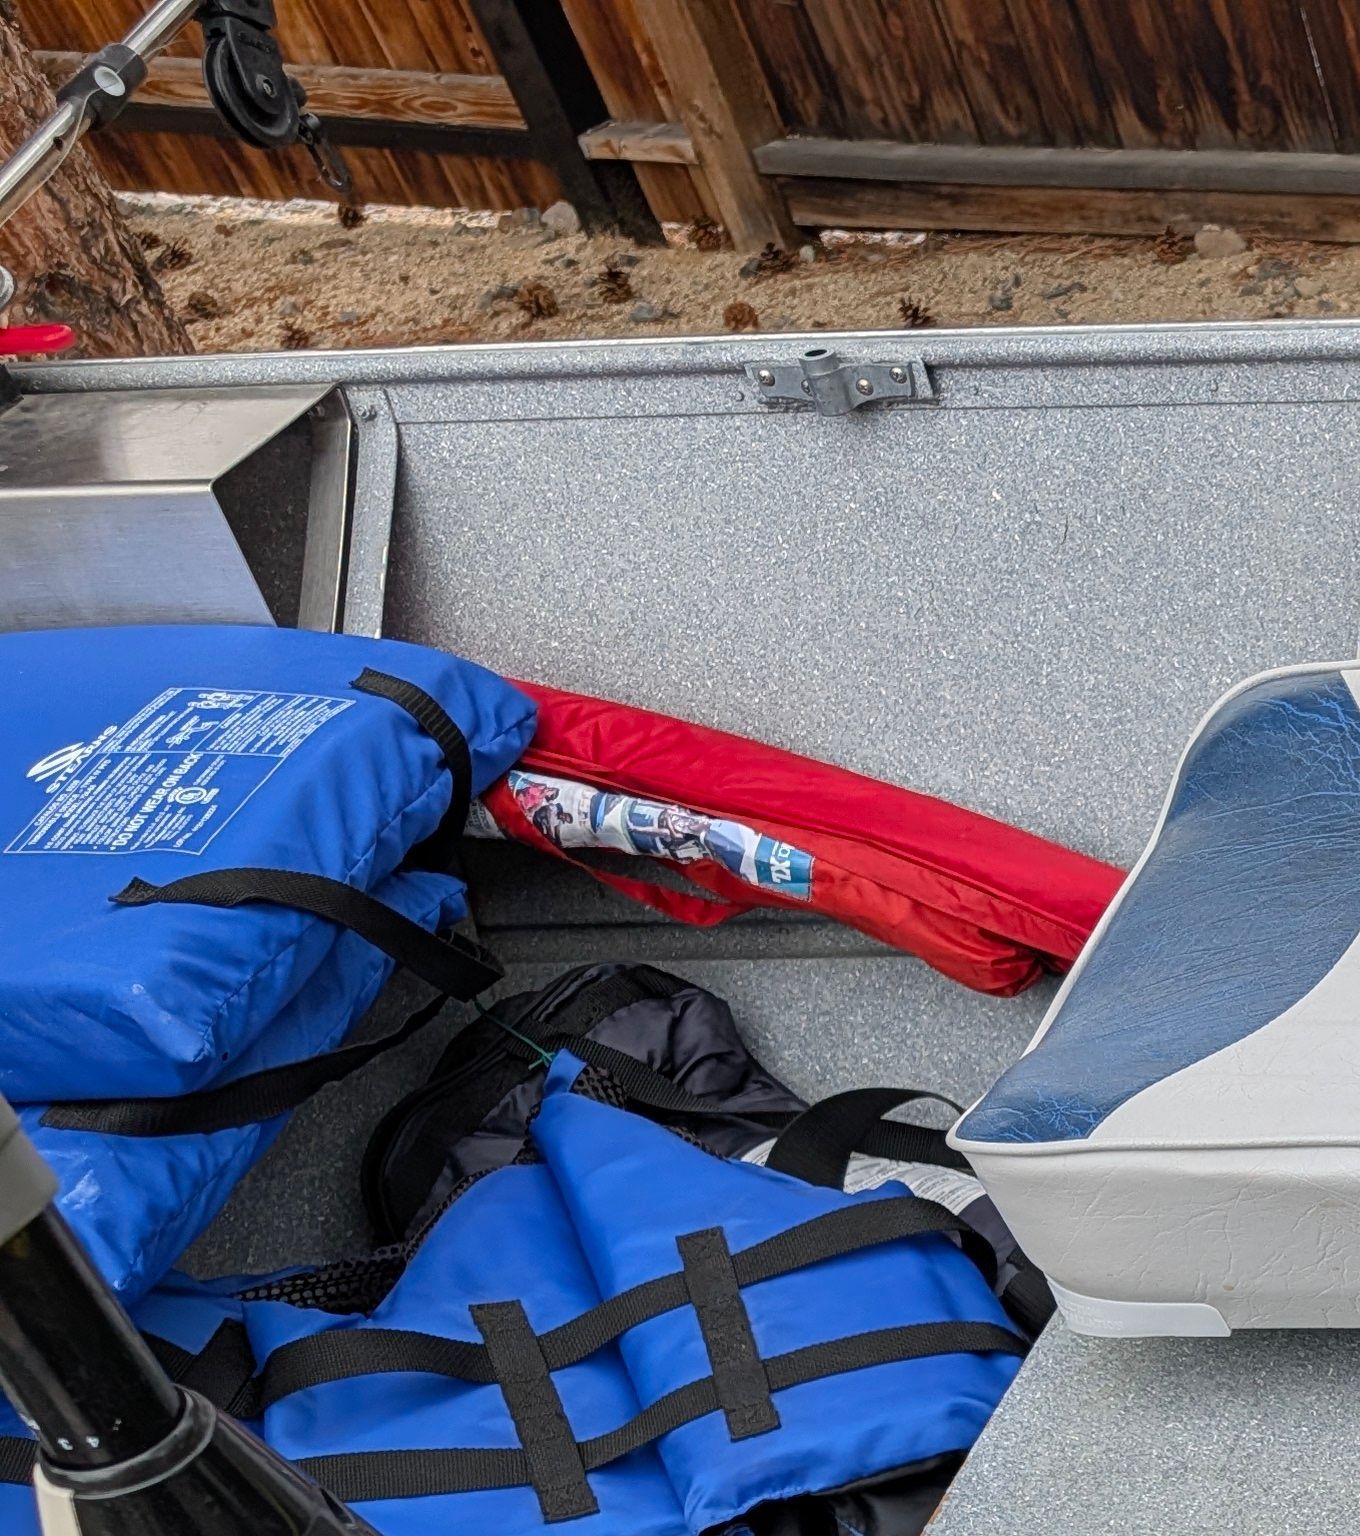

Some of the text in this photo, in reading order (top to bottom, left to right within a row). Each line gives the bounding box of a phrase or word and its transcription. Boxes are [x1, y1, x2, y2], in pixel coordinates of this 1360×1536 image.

[45, 725, 118, 794] STEARNS
[114, 833, 133, 847] DO
[124, 813, 149, 832] NOT
[139, 788, 171, 814] WEAR
[162, 773, 184, 788] ON
[177, 752, 205, 775] BACK
